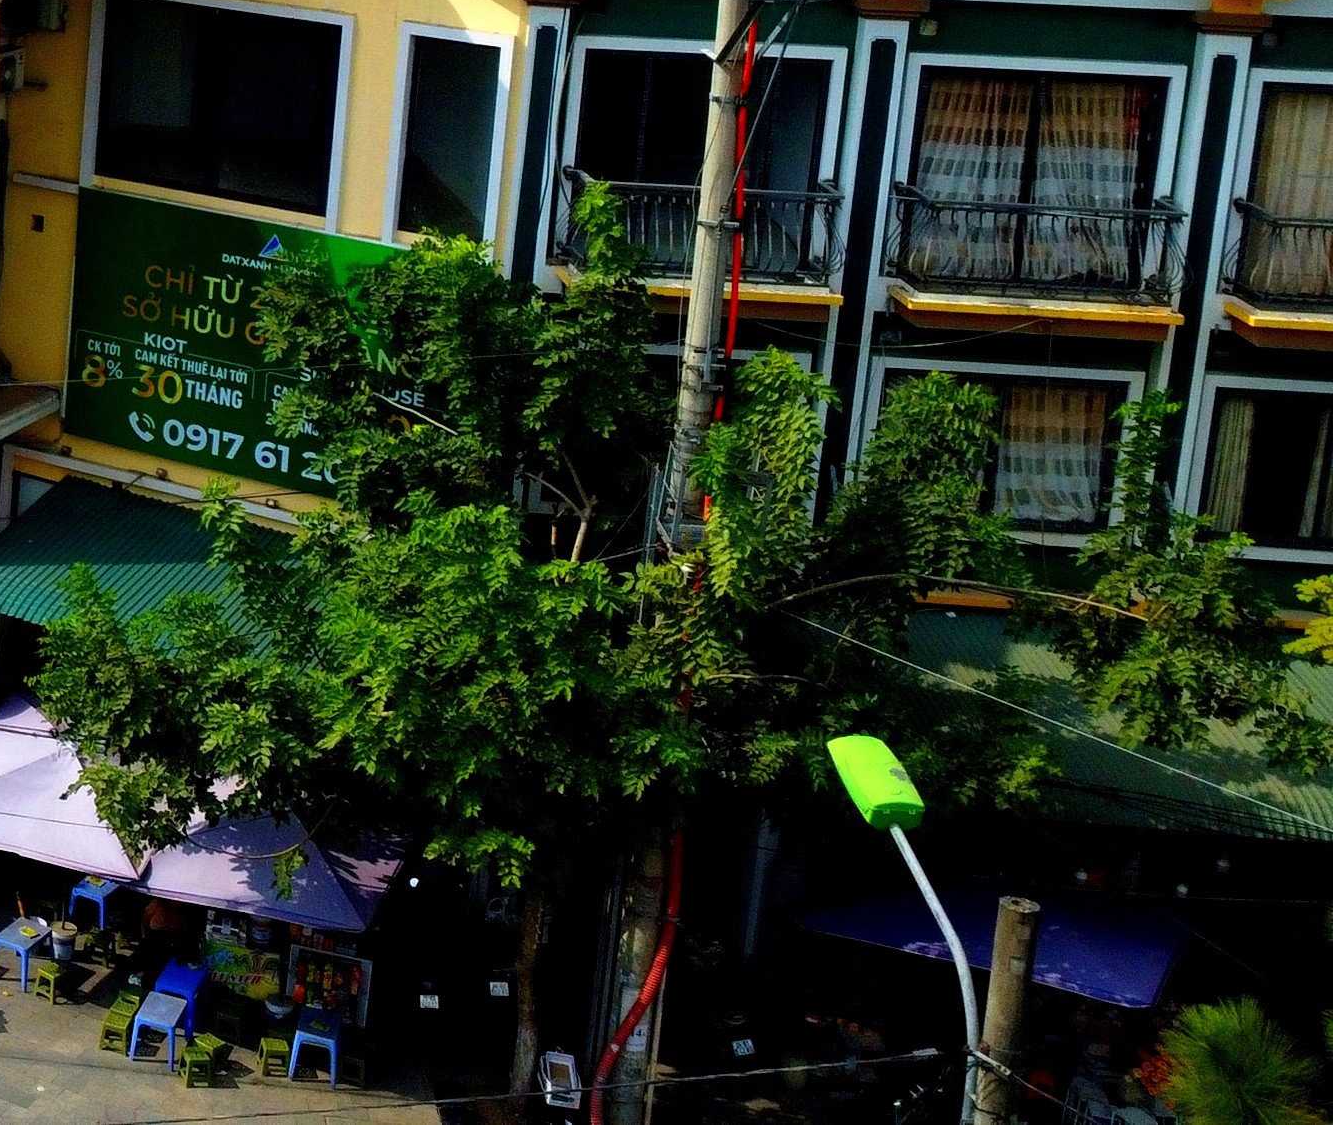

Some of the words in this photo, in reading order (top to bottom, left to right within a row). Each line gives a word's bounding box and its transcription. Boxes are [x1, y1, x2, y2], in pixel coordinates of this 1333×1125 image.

[221, 253, 271, 272] DATXANH
[202, 273, 244, 304] TỪ
[121, 291, 162, 322] SỞ
[171, 304, 235, 339] HỮU
[87, 339, 102, 353] CK
[103, 342, 121, 357] TỚI
[143, 331, 188, 354] KIOT
[134, 348, 158, 365] CAM
[159, 353, 180, 369] KẾT
[181, 358, 209, 376] THUÊ
[210, 365, 228, 382] LẠI
[229, 369, 248, 385] TỚI
[131, 362, 183, 405] 30
[185, 378, 243, 410] THÁNG
[162, 418, 245, 460] 0917
[254, 440, 290, 473] 61
